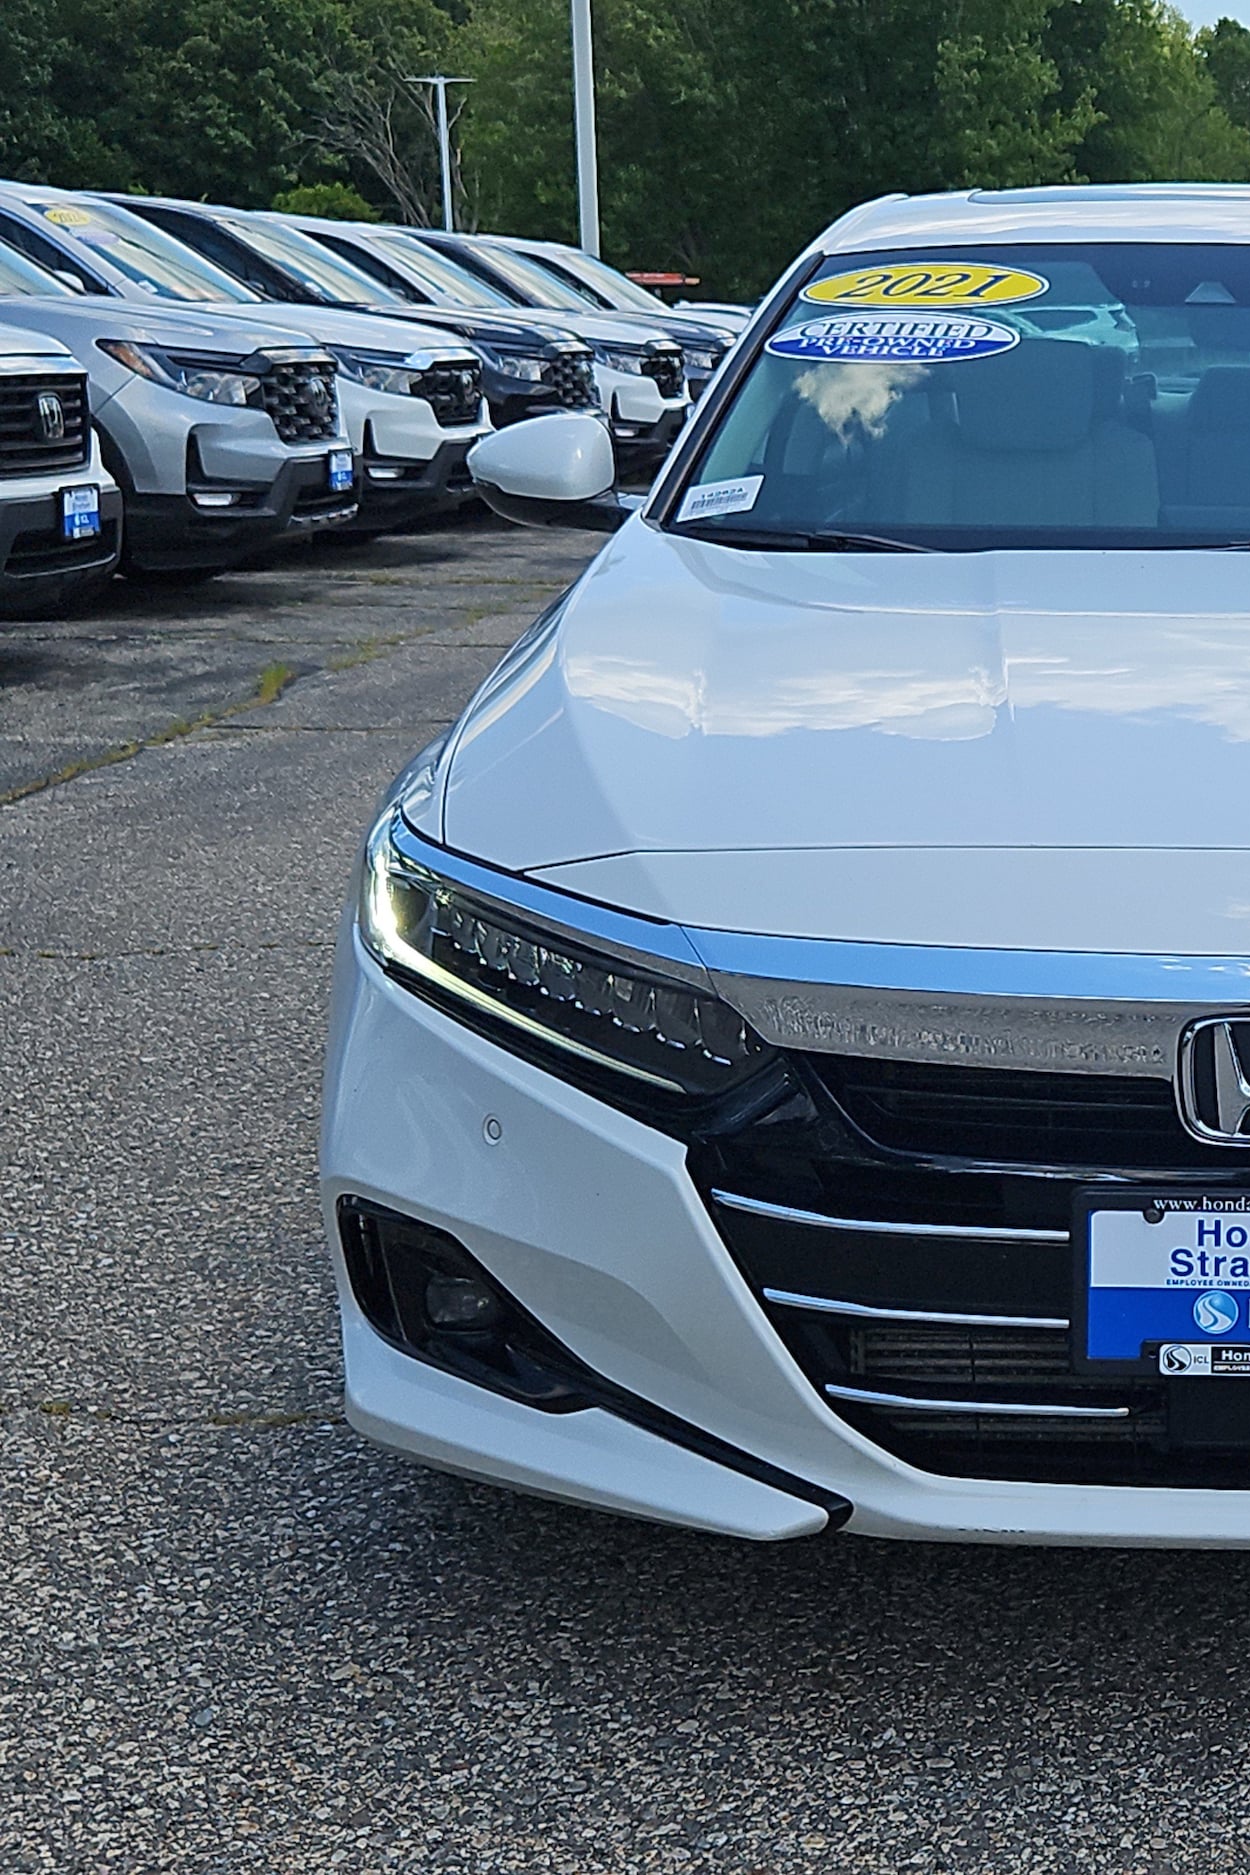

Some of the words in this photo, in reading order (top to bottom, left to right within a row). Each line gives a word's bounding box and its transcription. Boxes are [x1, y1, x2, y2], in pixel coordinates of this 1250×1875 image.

[834, 273, 1012, 299] 2021
[800, 321, 993, 338] CERTIFIED
[798, 336, 976, 350] PRE-OWNED
[822, 345, 945, 357] VEHICLE
[1193, 1355, 1209, 1364] ICL
